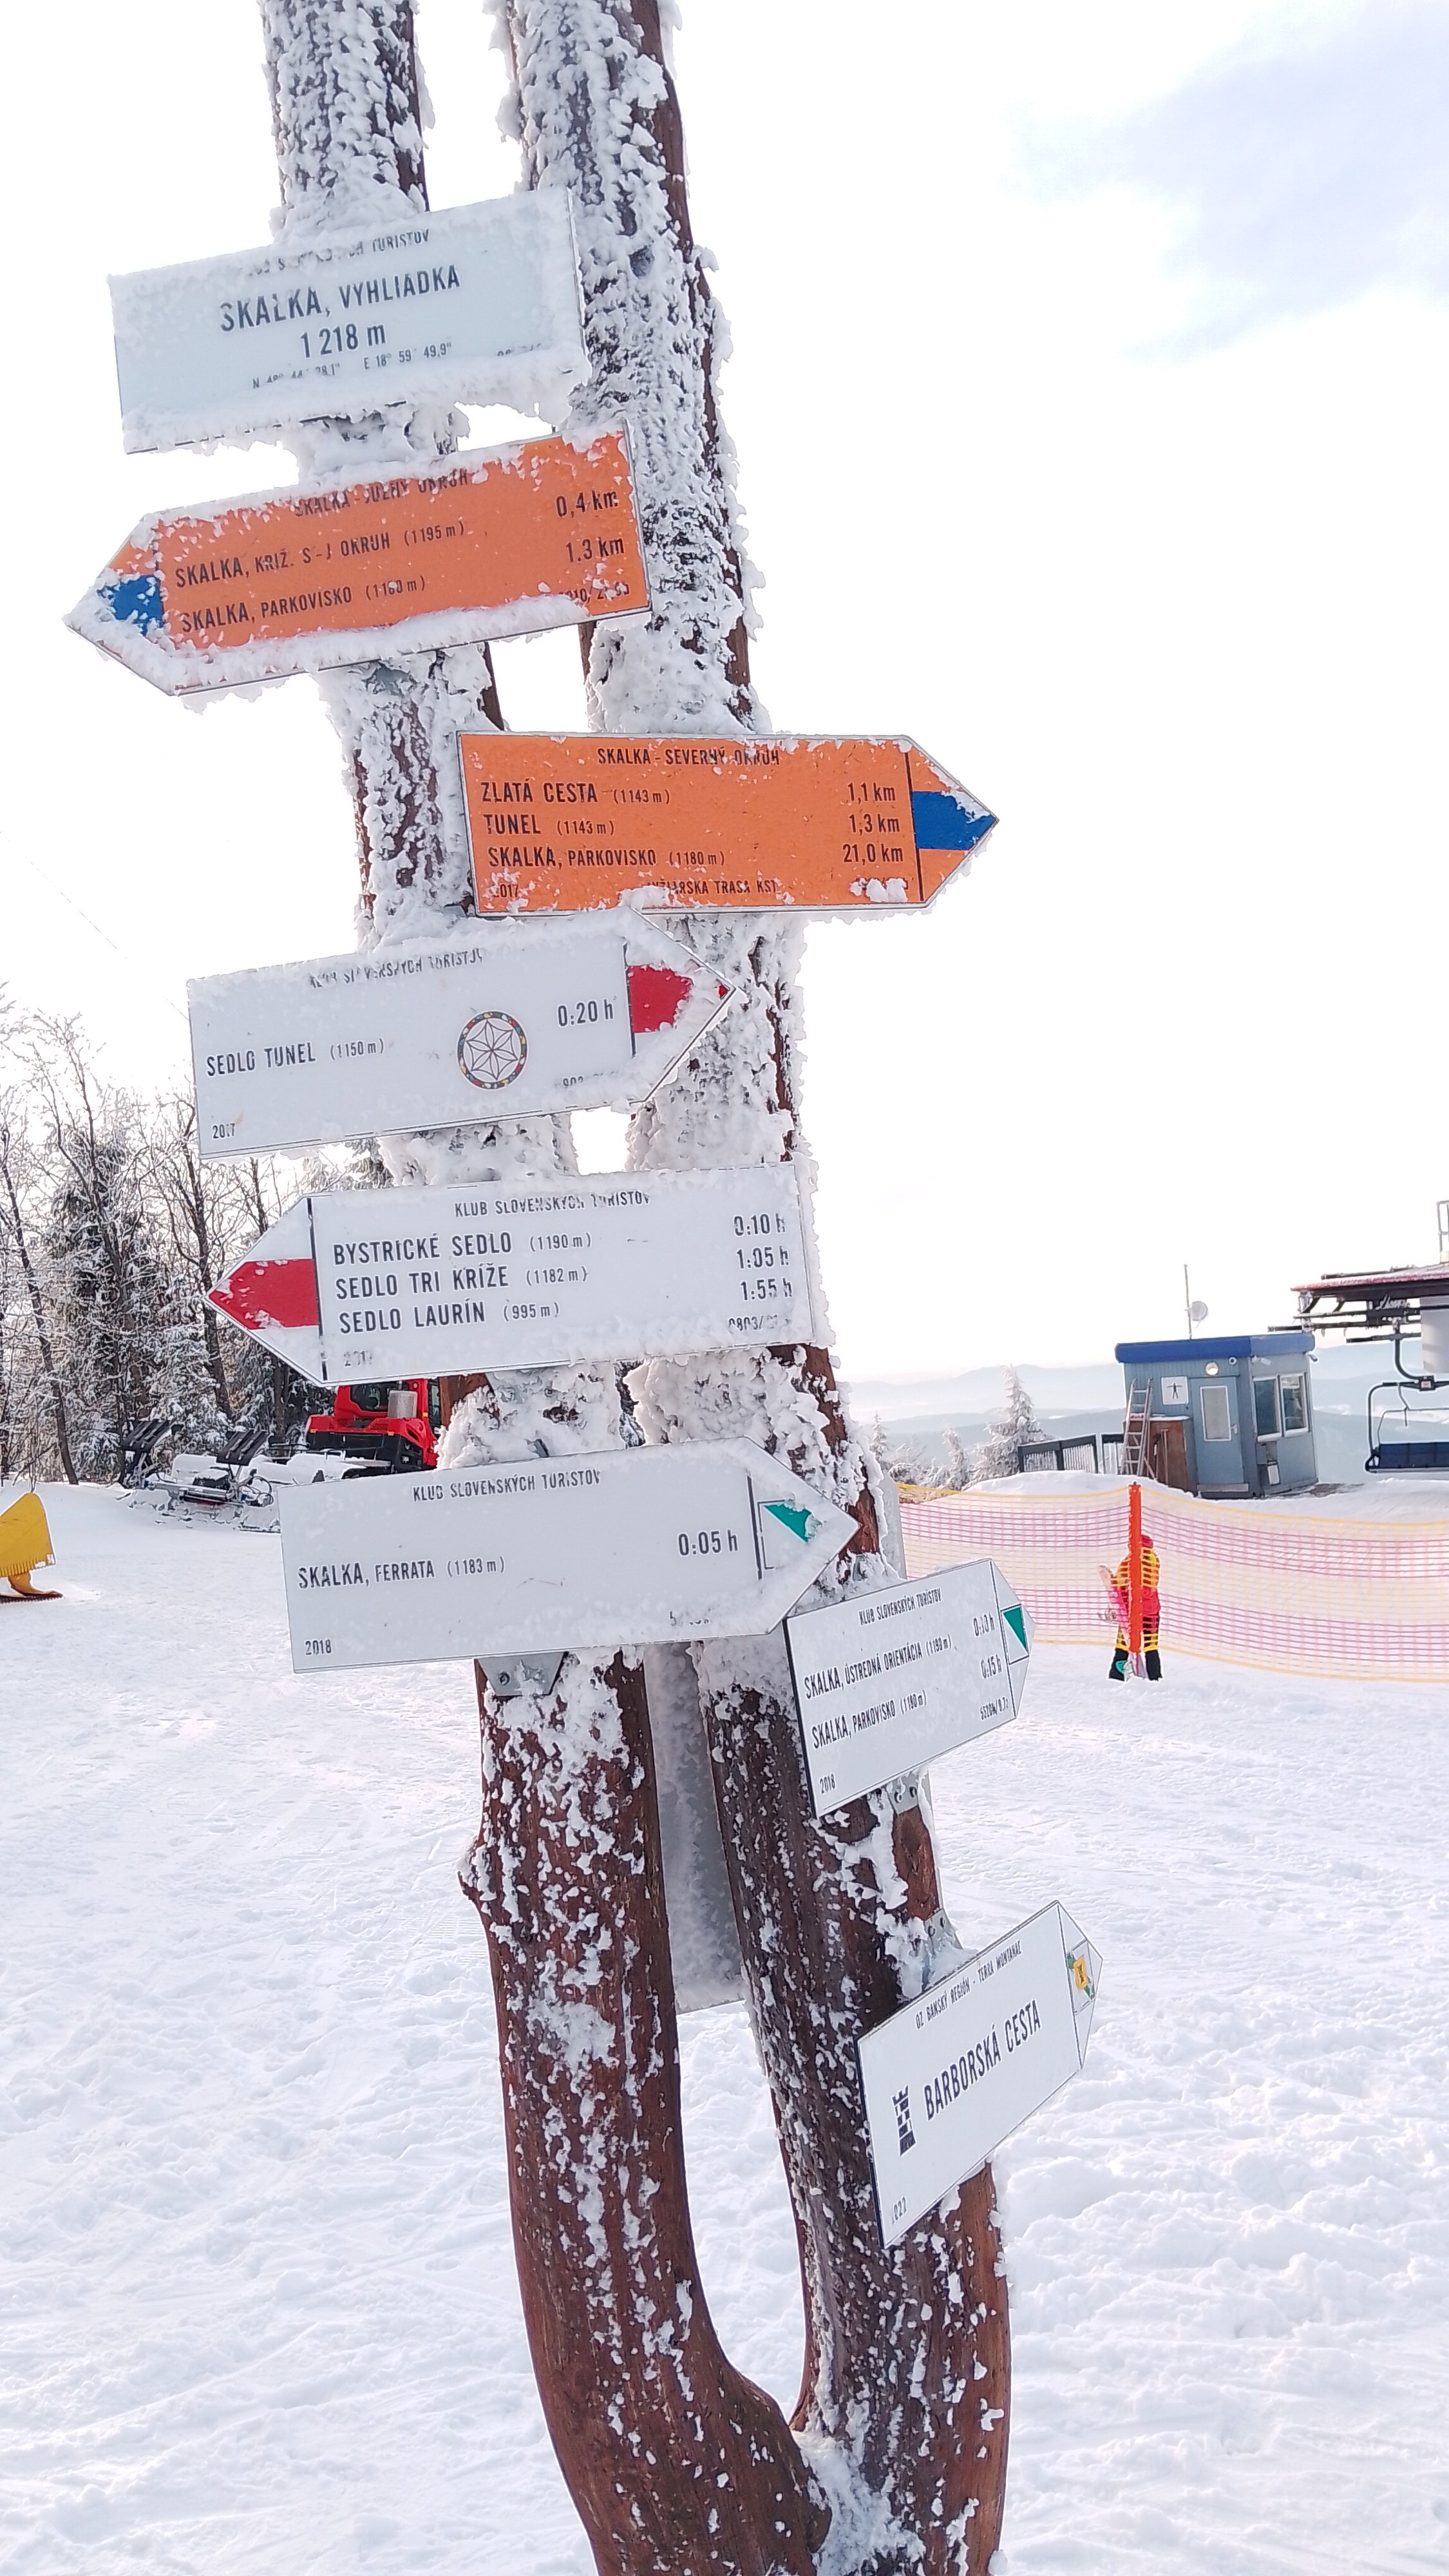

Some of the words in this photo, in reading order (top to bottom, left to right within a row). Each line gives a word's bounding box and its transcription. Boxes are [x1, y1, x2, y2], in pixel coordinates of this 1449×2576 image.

[220, 287, 331, 332] SKALKA,
[339, 264, 460, 309] VYHLIADKA
[366, 325, 385, 346] m
[364, 357, 370, 370] E
[556, 491, 586, 518] 0,4
[593, 489, 618, 510] km
[175, 556, 249, 588] SKALKA,
[255, 549, 294, 573] KRIŽ.
[341, 533, 390, 556] OKRUH
[404, 524, 442, 547] (1195
[446, 520, 464, 538] m)
[599, 536, 624, 557] km
[182, 602, 256, 633] SKALKA,
[261, 586, 352, 618] PARKOVISKO
[407, 575, 424, 591] m)
[598, 748, 651, 765] SKALKA
[666, 746, 725, 765] SEVERNÝ
[480, 778, 533, 804] ZLATÁ
[544, 782, 598, 804] CESTA
[613, 789, 649, 804] (1143
[652, 789, 670, 804] m)
[847, 782, 869, 804] 1,1
[874, 782, 896, 802] km
[483, 813, 542, 835] TUNEL
[556, 820, 593, 835] (1143
[597, 820, 614, 835] m)
[848, 813, 873, 835] 1,3
[878, 813, 900, 833] km
[488, 846, 563, 869] SKALKA,
[568, 849, 657, 867] PARKOVISKO
[668, 851, 705, 867] (1180
[707, 850, 726, 866] m)
[842, 844, 876, 866] 21,0
[882, 844, 904, 863] km
[493, 884, 518, 898] 017
[206, 1050, 255, 1077] SEDLO
[263, 1041, 316, 1068] TUNEL
[330, 1040, 364, 1061] (1150
[367, 1037, 384, 1055] m)
[558, 1000, 598, 1027] 0:20
[603, 999, 613, 1020] h
[213, 1122, 235, 1139] 2017
[455, 1201, 488, 1217] KLUB
[334, 1233, 440, 1265] BYSTRICKÉ
[452, 1231, 512, 1256] SEDLO
[529, 1235, 569, 1253] (1190
[573, 1232, 592, 1249] m)
[734, 1214, 770, 1237] 0:10
[775, 1213, 786, 1233] h
[336, 1274, 398, 1300] SEDLO
[409, 1271, 440, 1294] TRI
[453, 1263, 509, 1290] KRÍŽE
[526, 1268, 565, 1287] (1182
[568, 1266, 588, 1283] m)
[737, 1246, 774, 1270] 1:05
[780, 1245, 789, 1265] h
[339, 1307, 401, 1334] SEDLO
[414, 1298, 485, 1327] LAURÍN
[503, 1304, 537, 1321] (995
[541, 1302, 560, 1318] m)
[741, 1278, 778, 1301] 1:55
[783, 1278, 793, 1298] h
[413, 1485, 443, 1501] KLUB
[451, 1474, 535, 1498] SLOVENSKÝCH
[542, 1469, 600, 1489] TURISTOV
[298, 1562, 369, 1589] SKALKA,
[375, 1560, 435, 1582] FERRATA
[447, 1557, 483, 1577] (1183
[487, 1555, 506, 1573] m)
[678, 1531, 721, 1556] 0:05
[728, 1530, 738, 1552] h
[858, 1608, 875, 1625] KLUB
[916, 1587, 941, 1608] TURISTOV
[305, 1639, 332, 1656] 2018
[804, 1667, 845, 1700] SKALKA,
[844, 1653, 882, 1684] ÚSTREDNÁ
[884, 1642, 922, 1671] ORIENTÁCIA
[989, 1613, 995, 1631] h
[811, 1714, 852, 1750] SKALKA,
[852, 1700, 896, 1734] PARKOVISKO
[981, 1656, 996, 1679] 0:15
[996, 1654, 1001, 1673] h
[820, 1773, 836, 1794] 2018
[915, 2011, 924, 2029] OZ
[926, 1990, 947, 2022] BANSKÝ
[951, 1976, 970, 2004] REGIÓN
[923, 2023, 1002, 2121] BARBORSKÁ
[1005, 1999, 1042, 2054] CESTA
